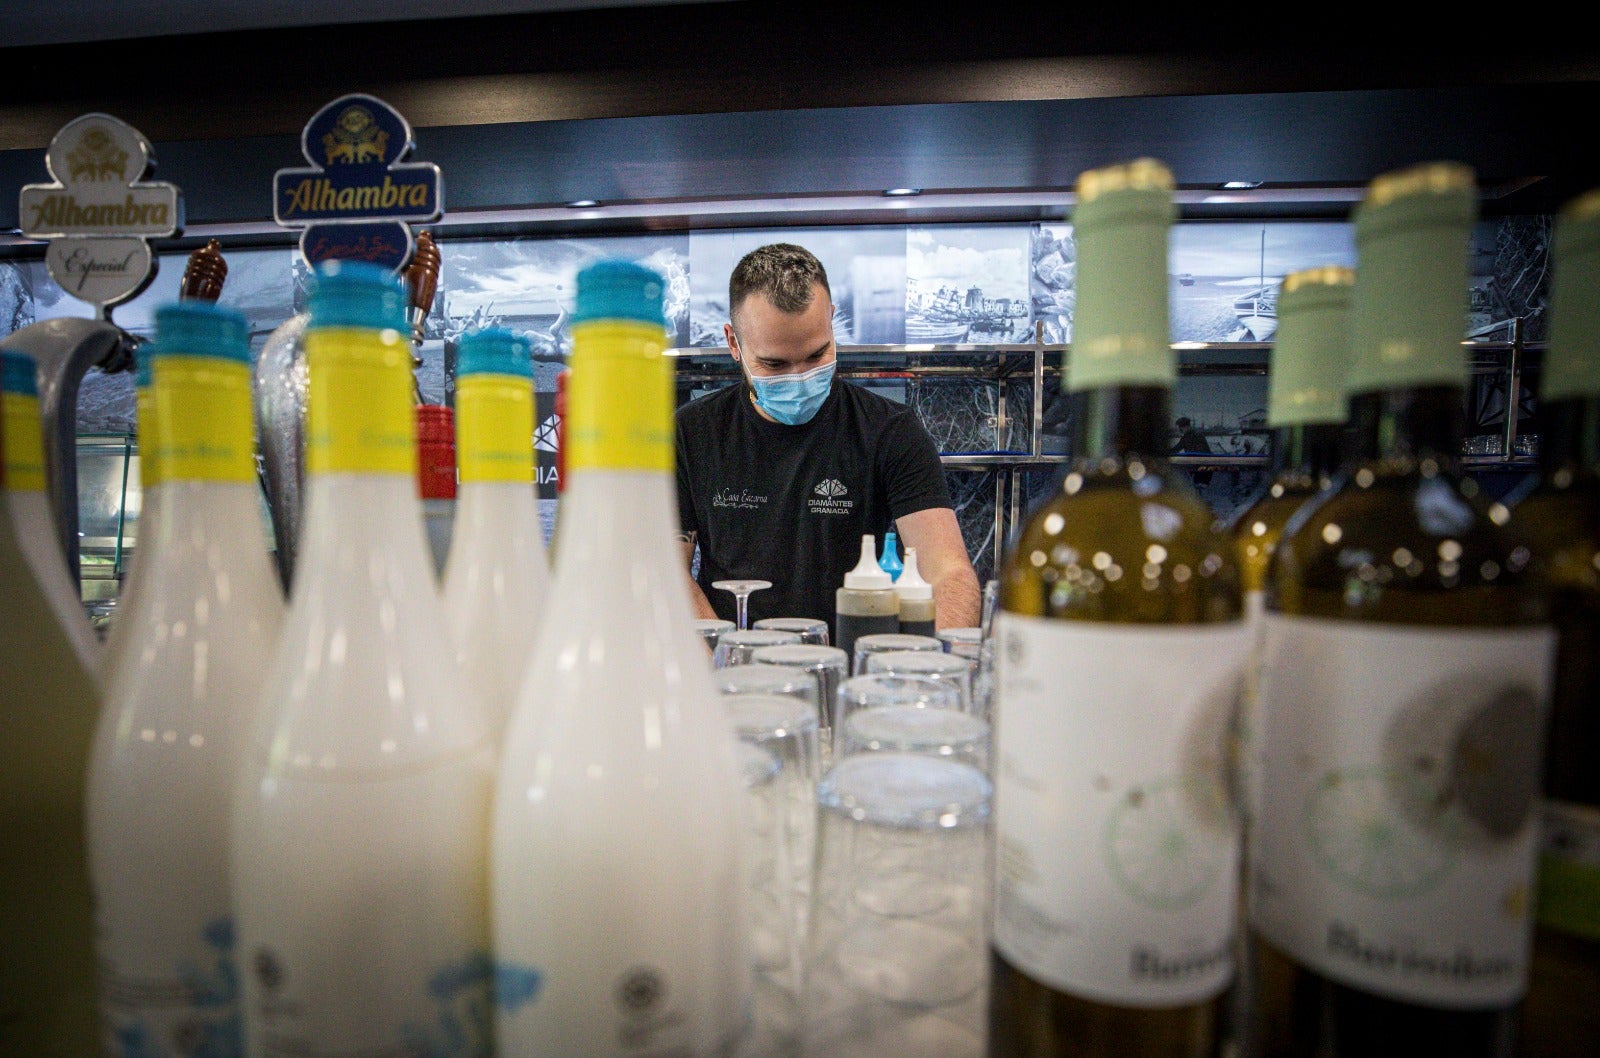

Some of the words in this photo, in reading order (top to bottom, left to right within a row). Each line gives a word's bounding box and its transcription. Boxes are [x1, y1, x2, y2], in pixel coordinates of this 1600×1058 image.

[30, 194, 169, 228] Alhambra
[285, 177, 428, 211] Alhambra
[56, 247, 139, 291] Especial
[722, 487, 740, 502] Casa
[807, 499, 853, 508] DIAMANTES
